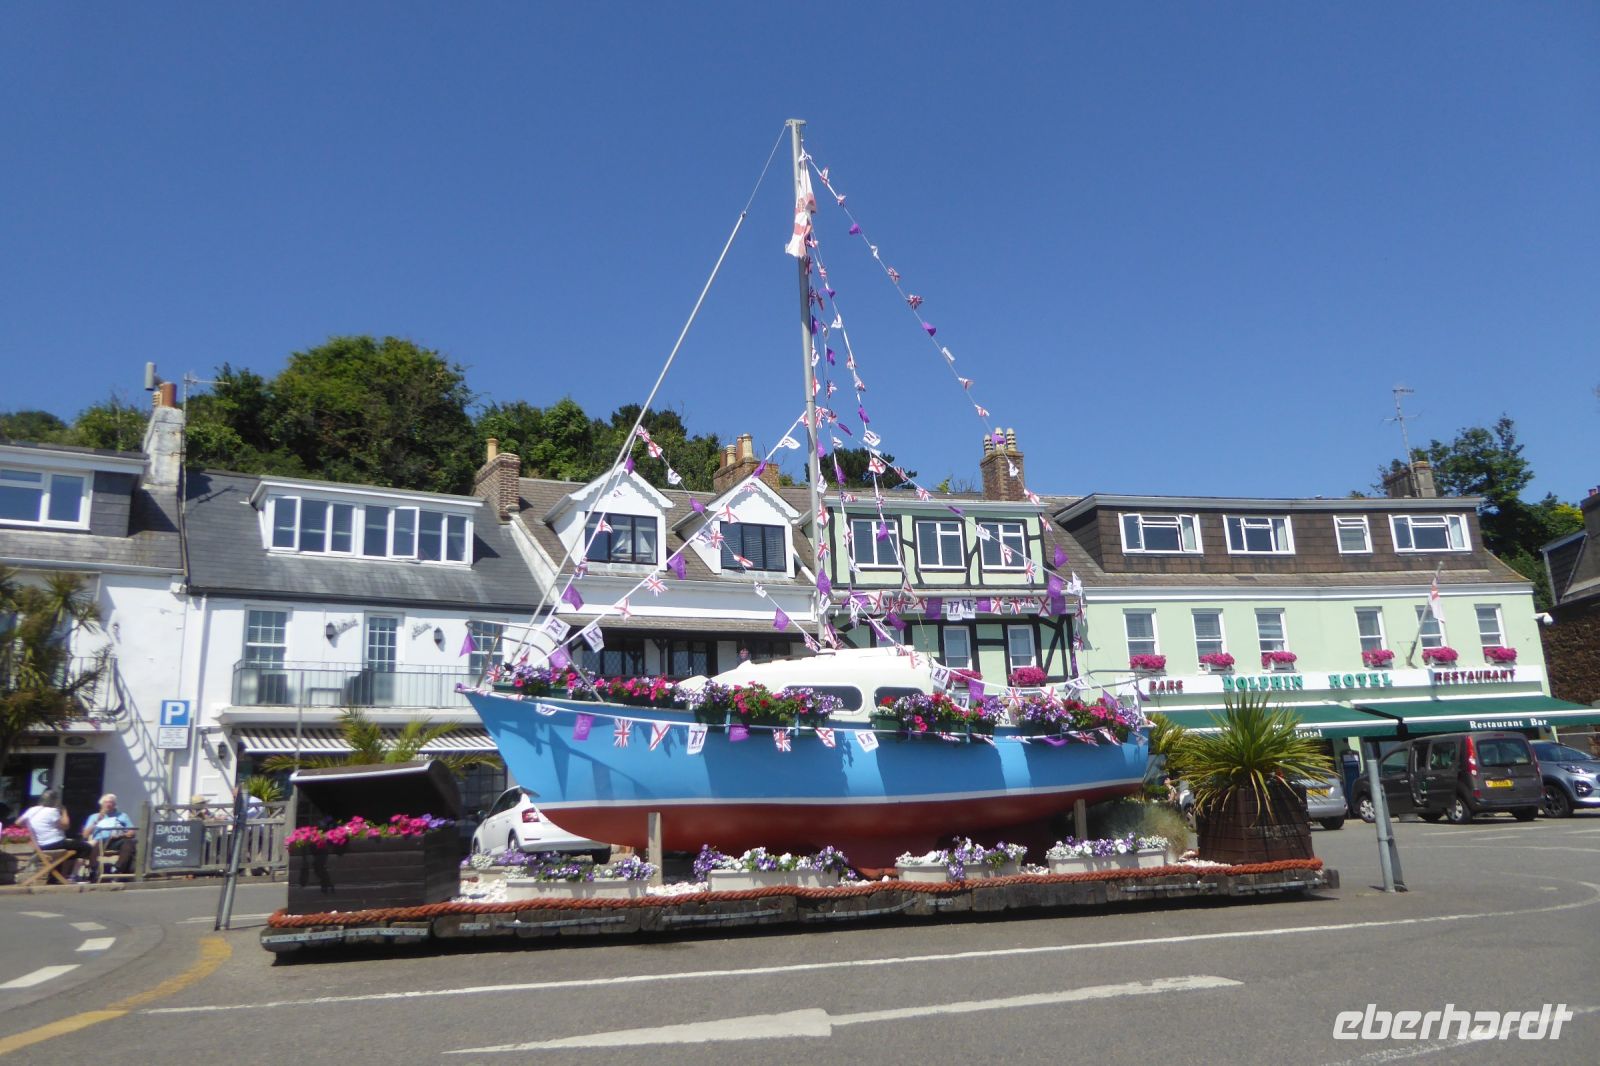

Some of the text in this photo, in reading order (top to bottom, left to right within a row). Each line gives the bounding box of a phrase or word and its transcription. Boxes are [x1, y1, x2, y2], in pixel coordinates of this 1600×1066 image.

[948, 601, 959, 613] 77
[1222, 673, 1392, 690] DOLPHIN HOTEL
[1433, 669, 1515, 682] RESTAURANT
[1149, 680, 1184, 692] BARS
[165, 702, 185, 724] P
[1469, 718, 1547, 729] Restaurant Bar
[690, 730, 705, 745] 77
[155, 824, 191, 835] BACON
[167, 834, 189, 843] ROLL
